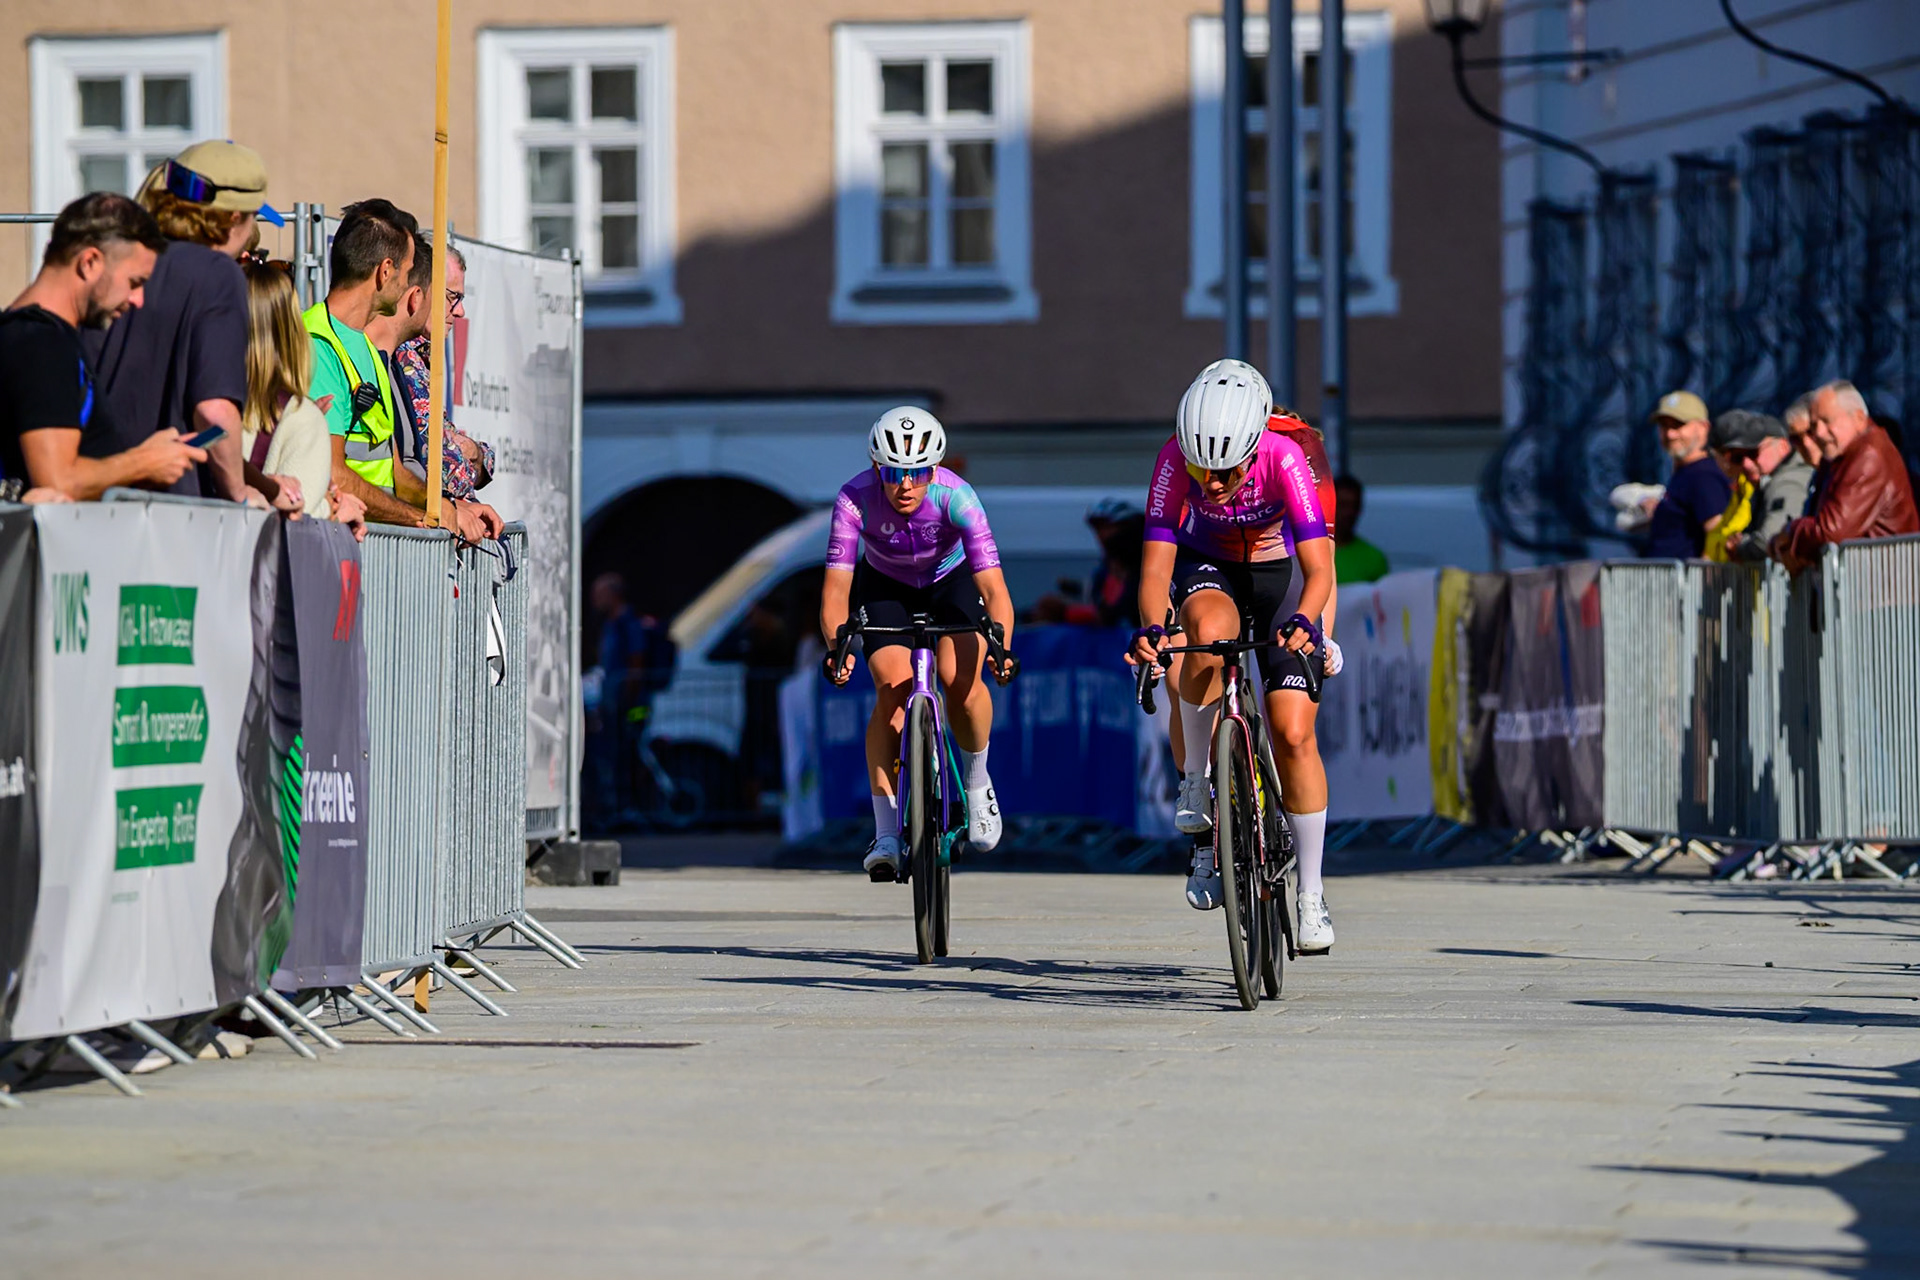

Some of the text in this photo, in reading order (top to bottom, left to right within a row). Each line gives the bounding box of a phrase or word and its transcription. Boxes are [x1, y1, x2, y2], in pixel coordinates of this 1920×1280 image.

[1150, 459, 1175, 518] Gothaer
[1291, 466, 1317, 523] MAKEMORE
[1186, 582, 1222, 593] uvex
[1282, 675, 1308, 688] ROS
